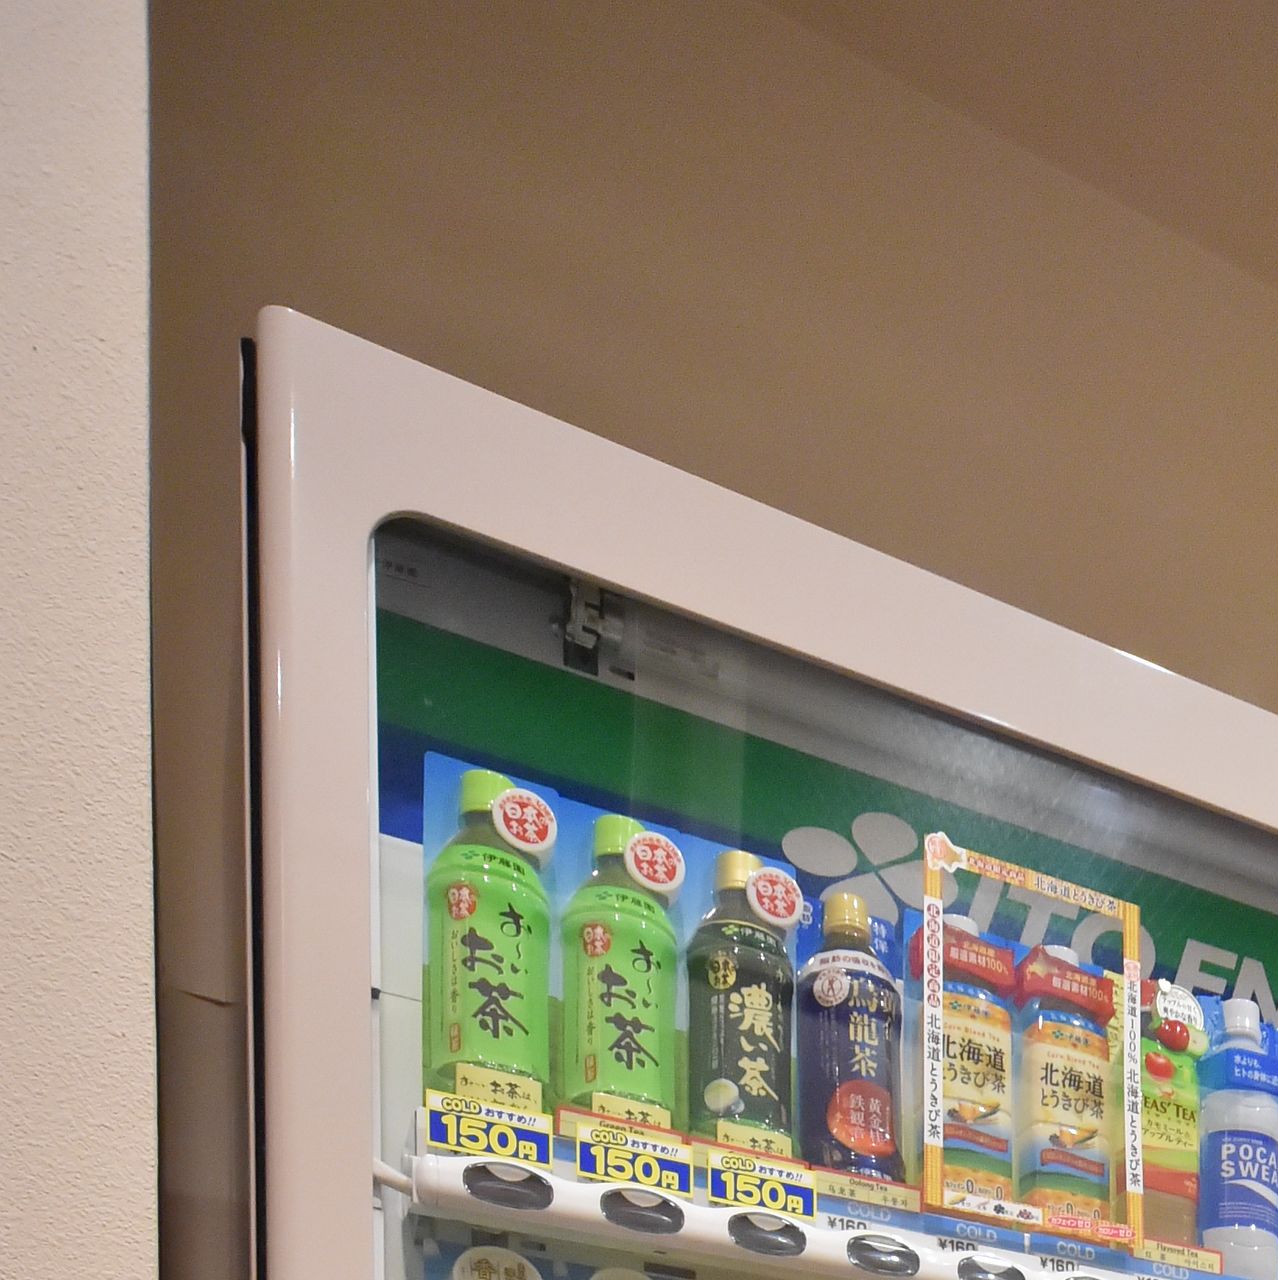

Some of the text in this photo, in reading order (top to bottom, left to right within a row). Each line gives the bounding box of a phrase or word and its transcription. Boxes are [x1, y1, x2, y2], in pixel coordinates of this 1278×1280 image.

[728, 982, 780, 1101] 濃い茶
[926, 1013, 942, 1139] 北海道とうきび茶
[1041, 1062, 1104, 1099] 北海道
[442, 1097, 537, 1127] COLD おすすめ!!
[1041, 1088, 1104, 1119] とうきび茶
[442, 1115, 538, 1161] 150円
[590, 1130, 679, 1157] COLD おすすめ!!
[1127, 1069, 1142, 1188] 北海道とうきび茶
[590, 1146, 679, 1190] 150円
[721, 1156, 803, 1181] COLD おすすめ!!
[721, 1172, 804, 1214] 150円
[956, 1223, 997, 1241] COLD
[1056, 1242, 1095, 1259] COLD
